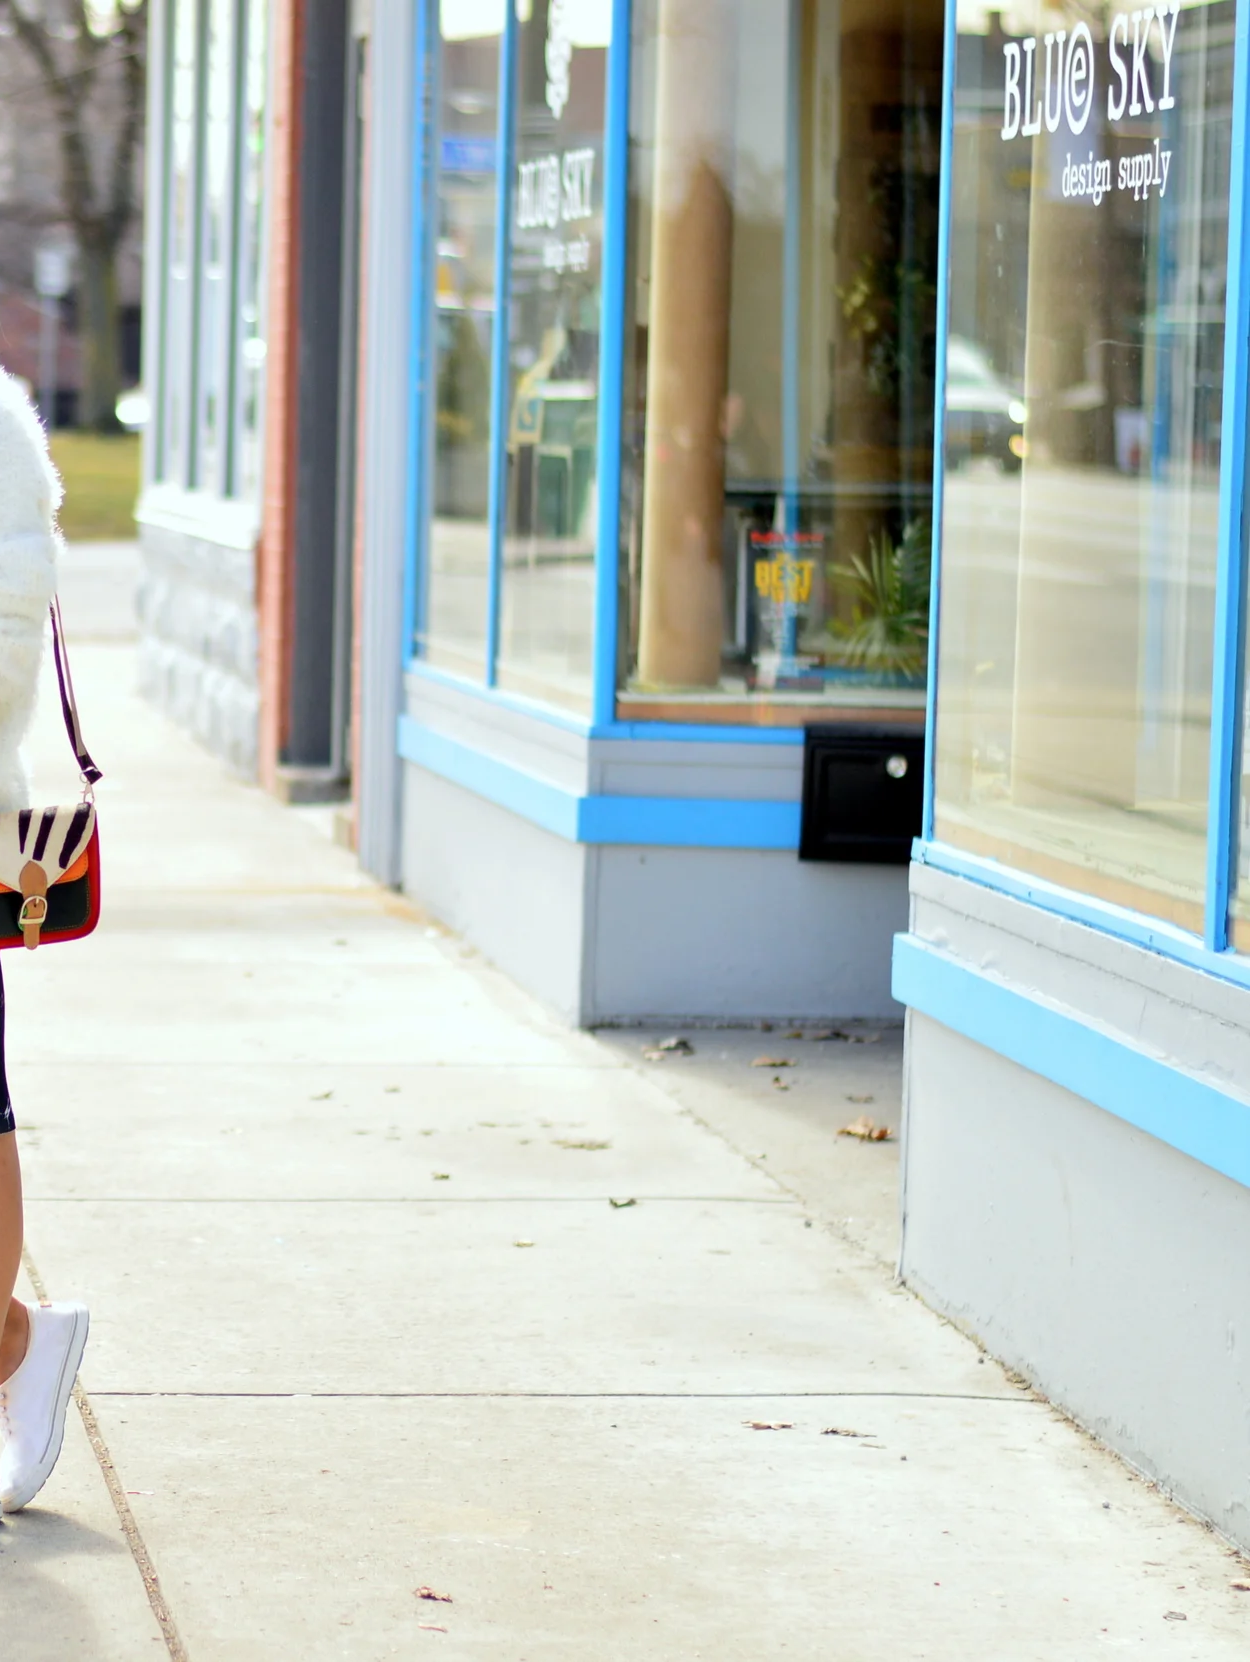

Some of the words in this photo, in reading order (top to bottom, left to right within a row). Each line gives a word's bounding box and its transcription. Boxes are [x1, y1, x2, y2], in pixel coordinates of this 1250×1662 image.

[1107, 2, 1180, 121] SKY
[561, 147, 594, 221] SKY
[1062, 151, 1112, 206] design
[1118, 138, 1172, 201] supply
[755, 559, 815, 590] BEST
